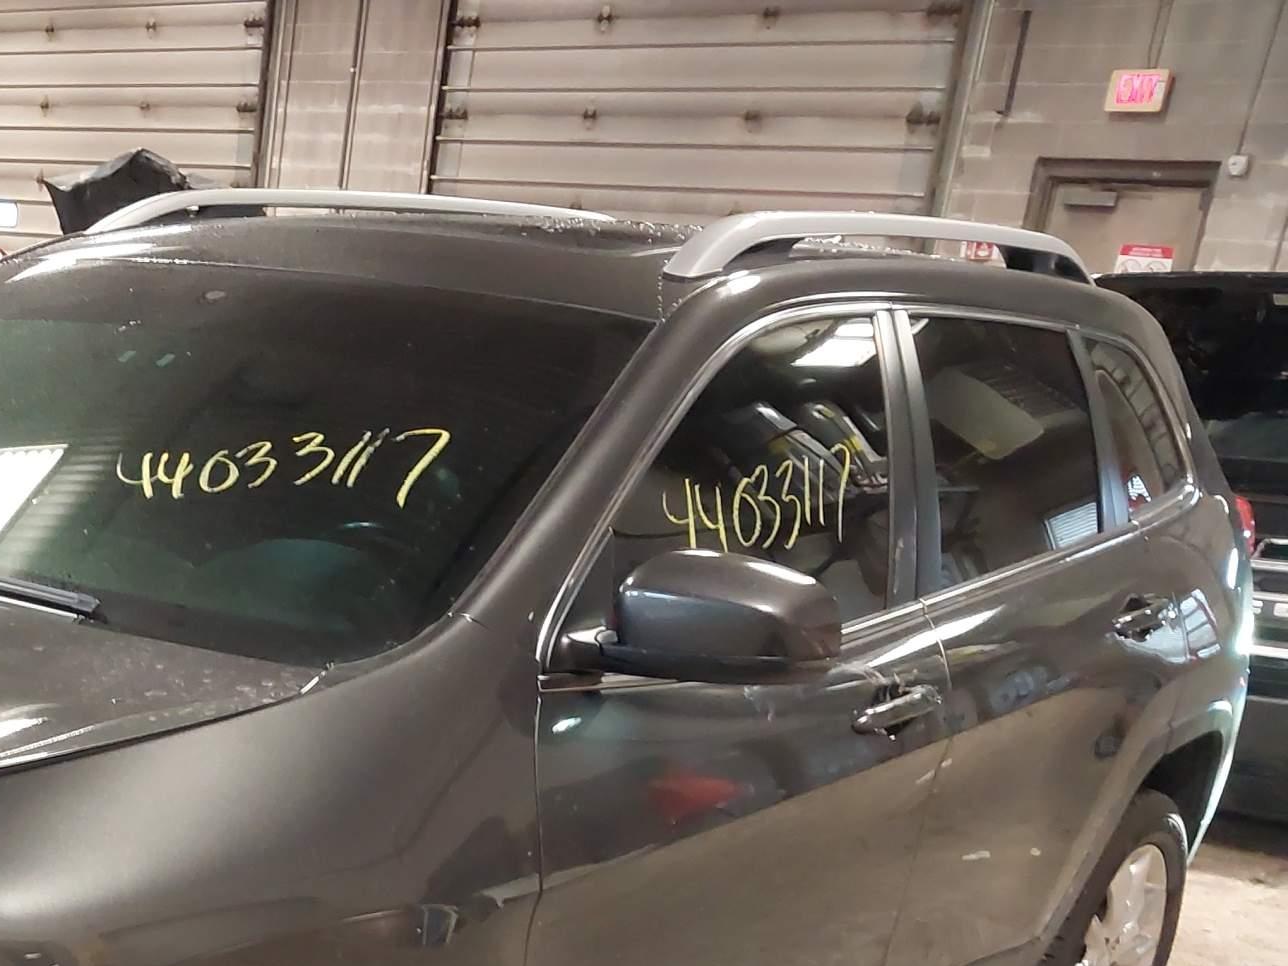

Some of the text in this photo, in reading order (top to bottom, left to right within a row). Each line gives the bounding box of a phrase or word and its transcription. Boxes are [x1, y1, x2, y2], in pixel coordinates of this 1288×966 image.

[1116, 74, 1160, 104] EXIT
[116, 428, 451, 508] 44033117
[663, 443, 850, 553] 44033117
